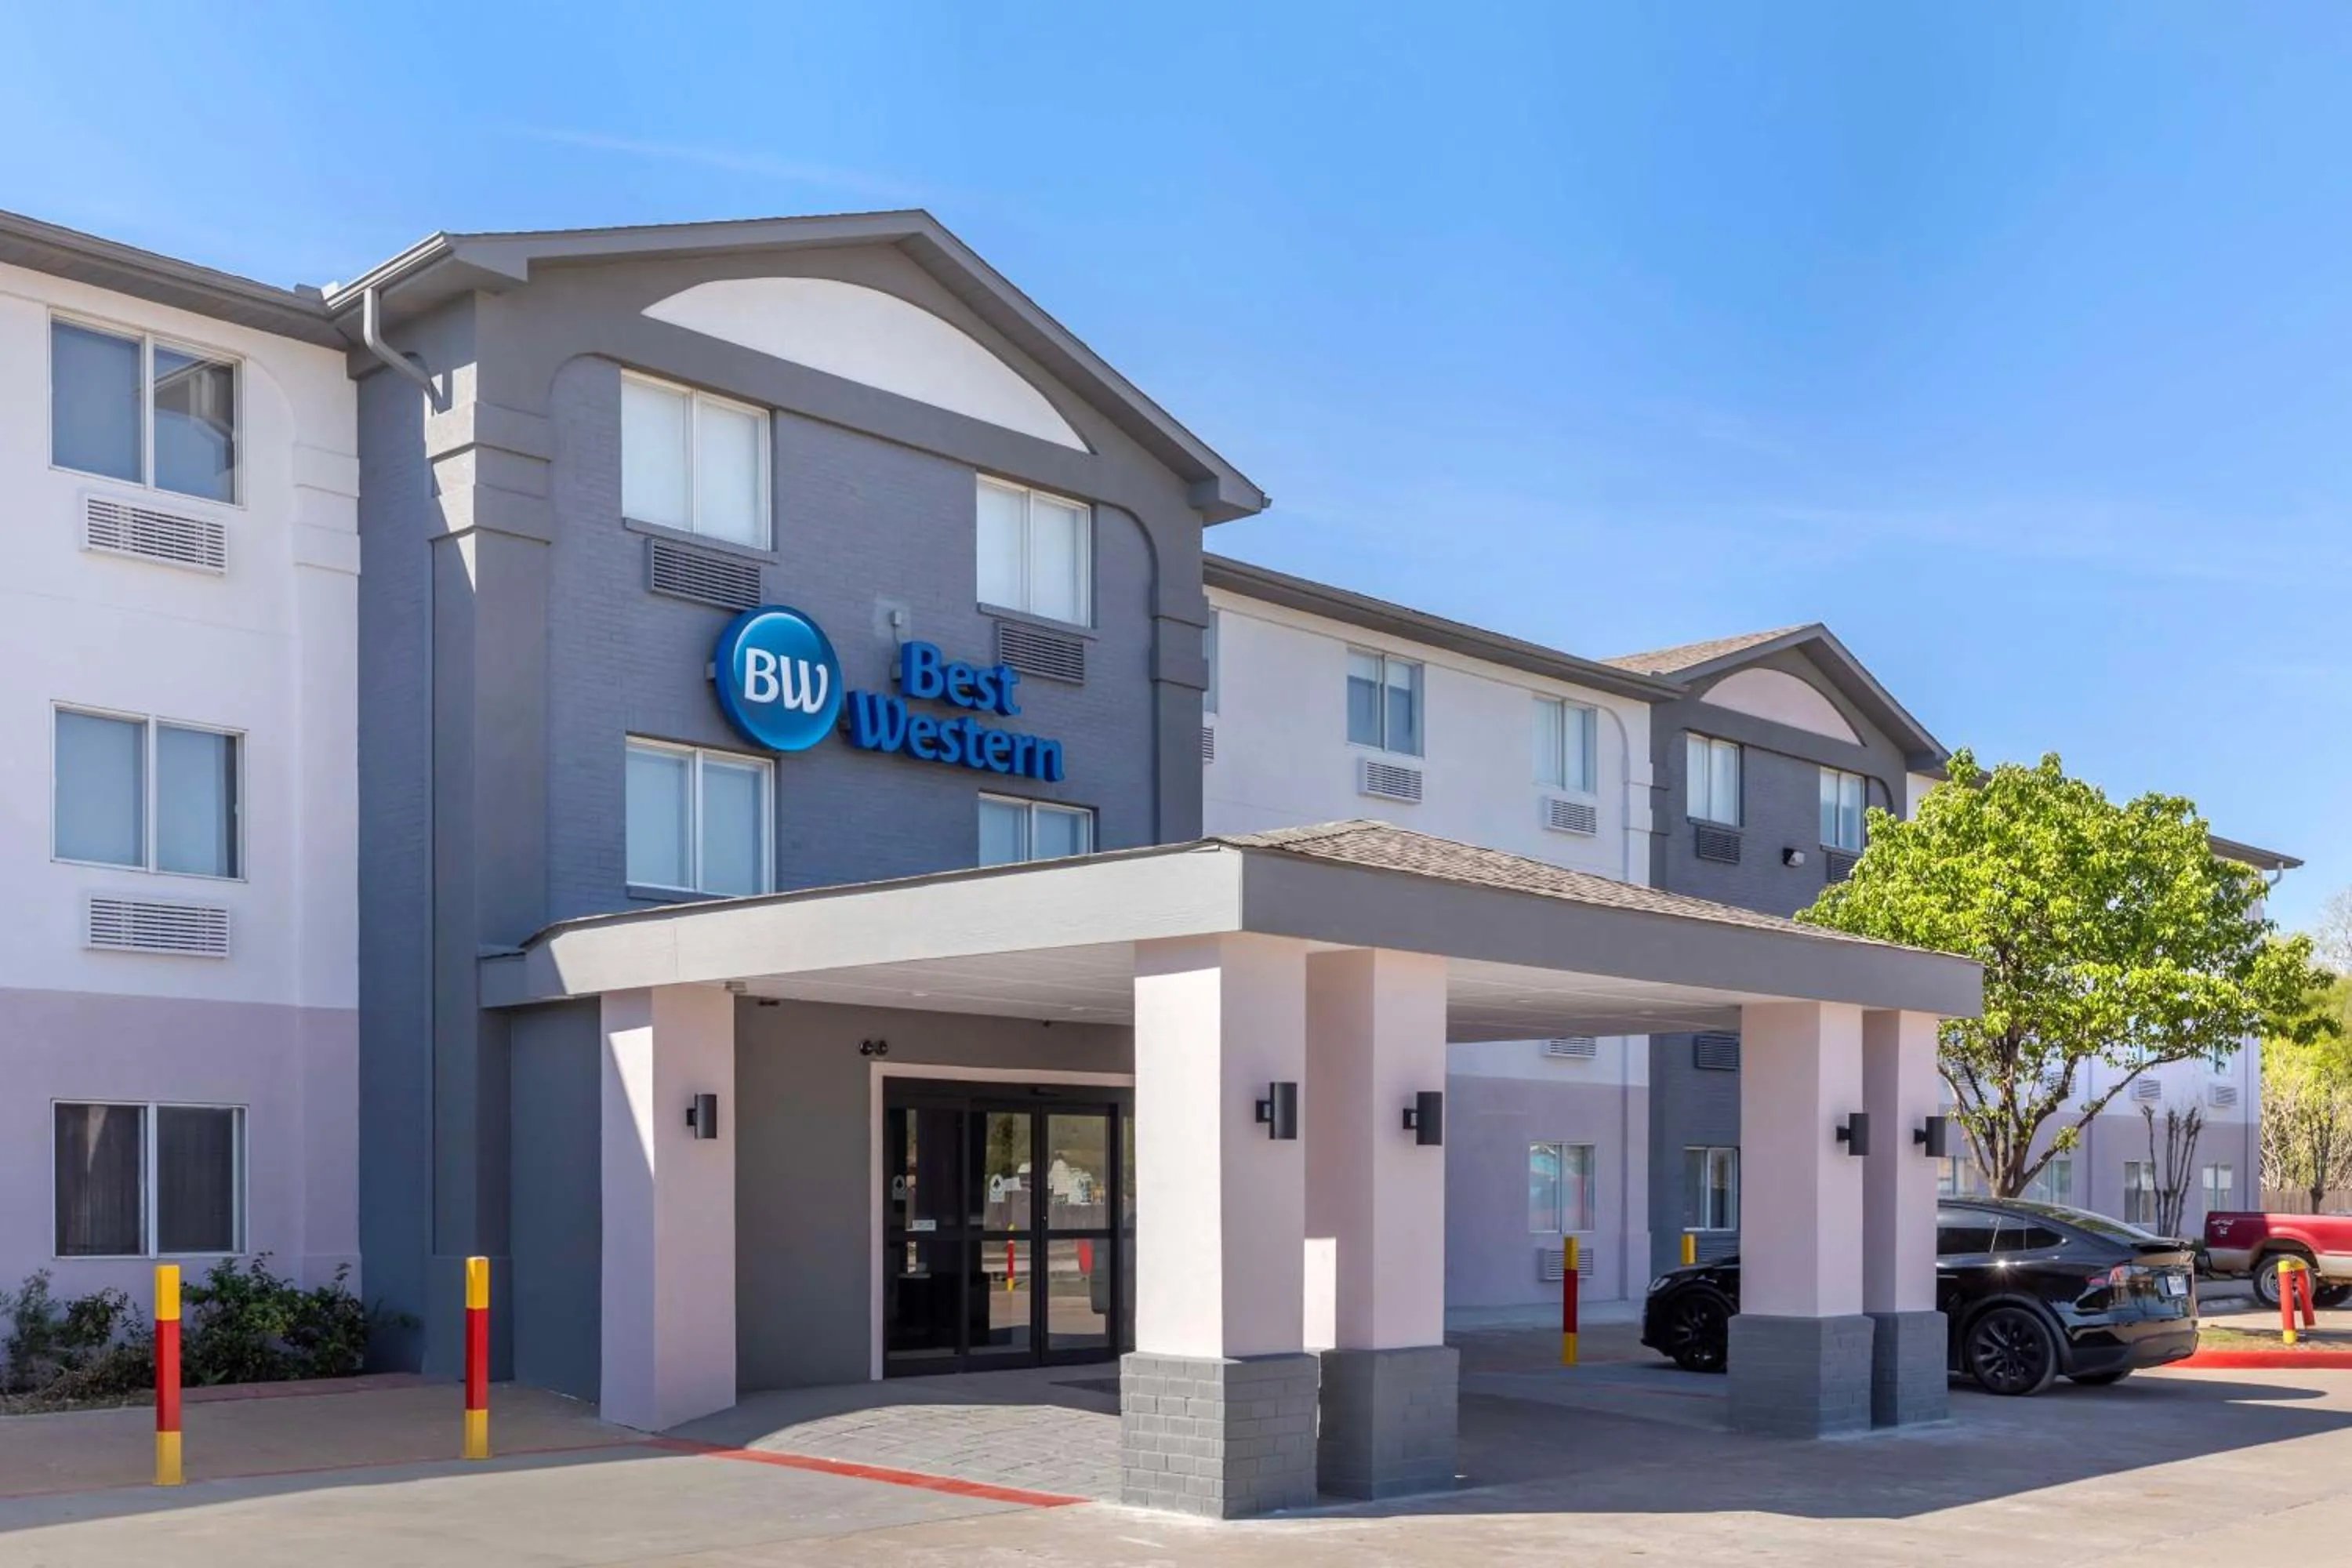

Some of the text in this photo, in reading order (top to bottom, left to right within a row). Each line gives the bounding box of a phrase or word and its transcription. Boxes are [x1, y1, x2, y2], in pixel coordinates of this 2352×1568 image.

[744, 647, 828, 713] BW
[902, 641, 1022, 716] Best
[848, 689, 1065, 782] Western
